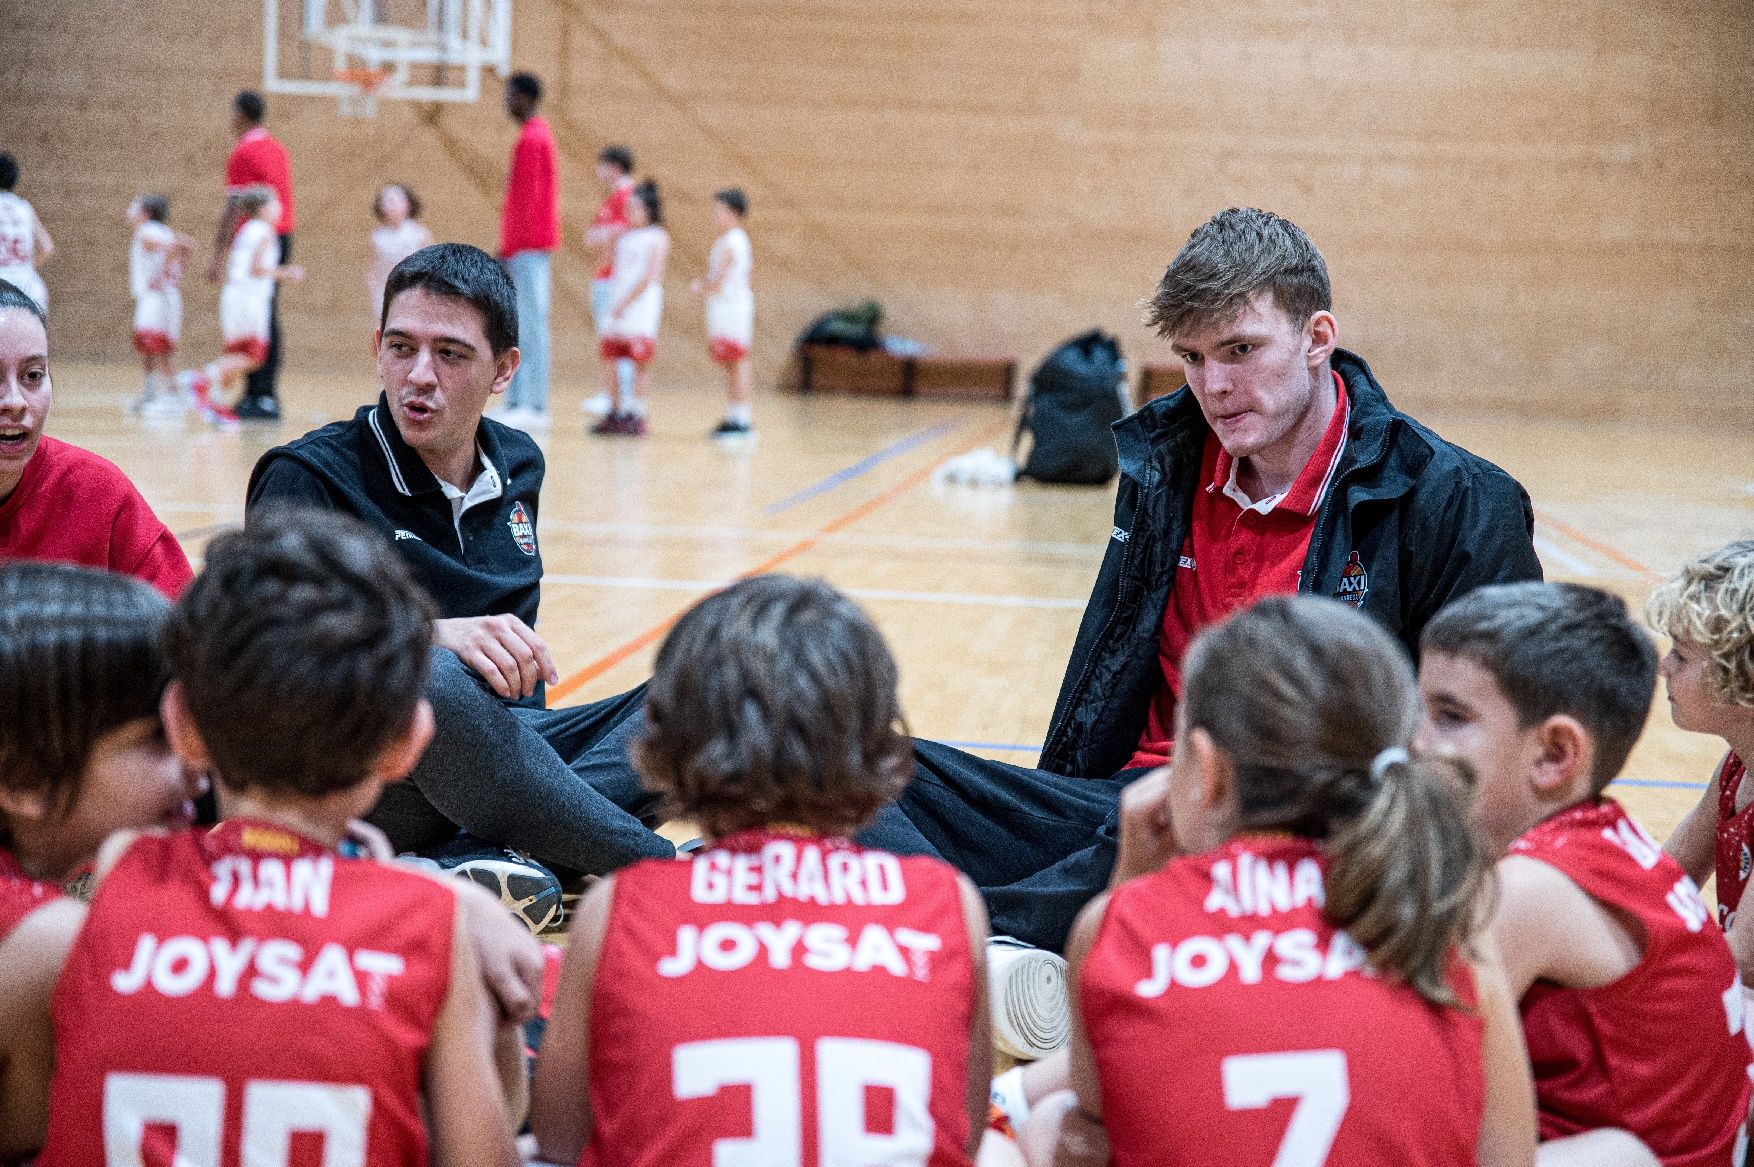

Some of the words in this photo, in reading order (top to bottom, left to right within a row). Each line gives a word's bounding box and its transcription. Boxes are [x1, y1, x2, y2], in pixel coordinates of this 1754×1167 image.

[690, 840, 907, 906] GERARD
[111, 932, 406, 1012] JOYSAT
[656, 918, 943, 983] JOYSAT
[1134, 928, 1376, 998] JOYSA
[1221, 1047, 1351, 1167] 7
